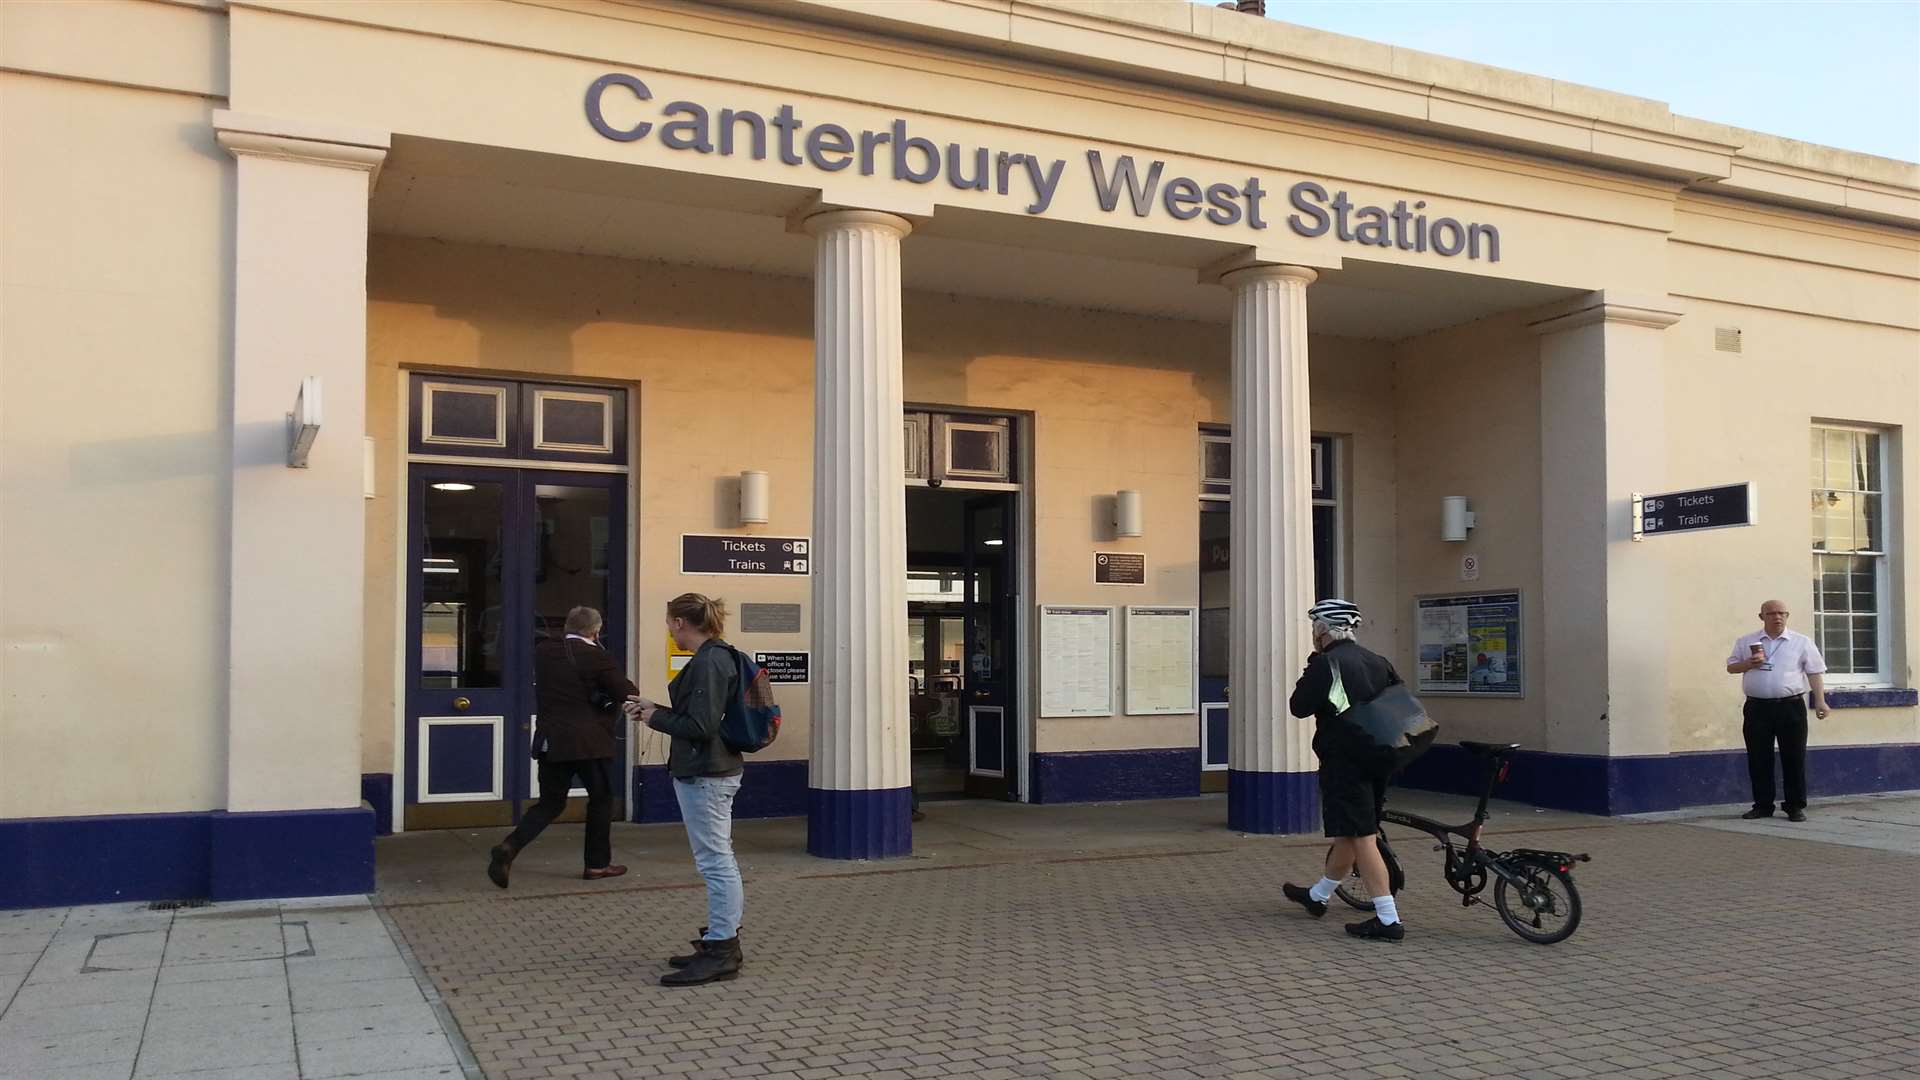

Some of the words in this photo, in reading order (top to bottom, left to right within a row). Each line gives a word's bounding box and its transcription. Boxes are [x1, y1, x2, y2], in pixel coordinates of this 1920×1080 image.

[584, 72, 1066, 215] Canterbury
[1087, 149, 1268, 230] West
[1289, 181, 1500, 262] Station
[1677, 495, 1714, 507] Tickets
[1678, 514, 1709, 526] Trains
[722, 540, 766, 552] Tickets
[728, 559, 766, 570] Trains
